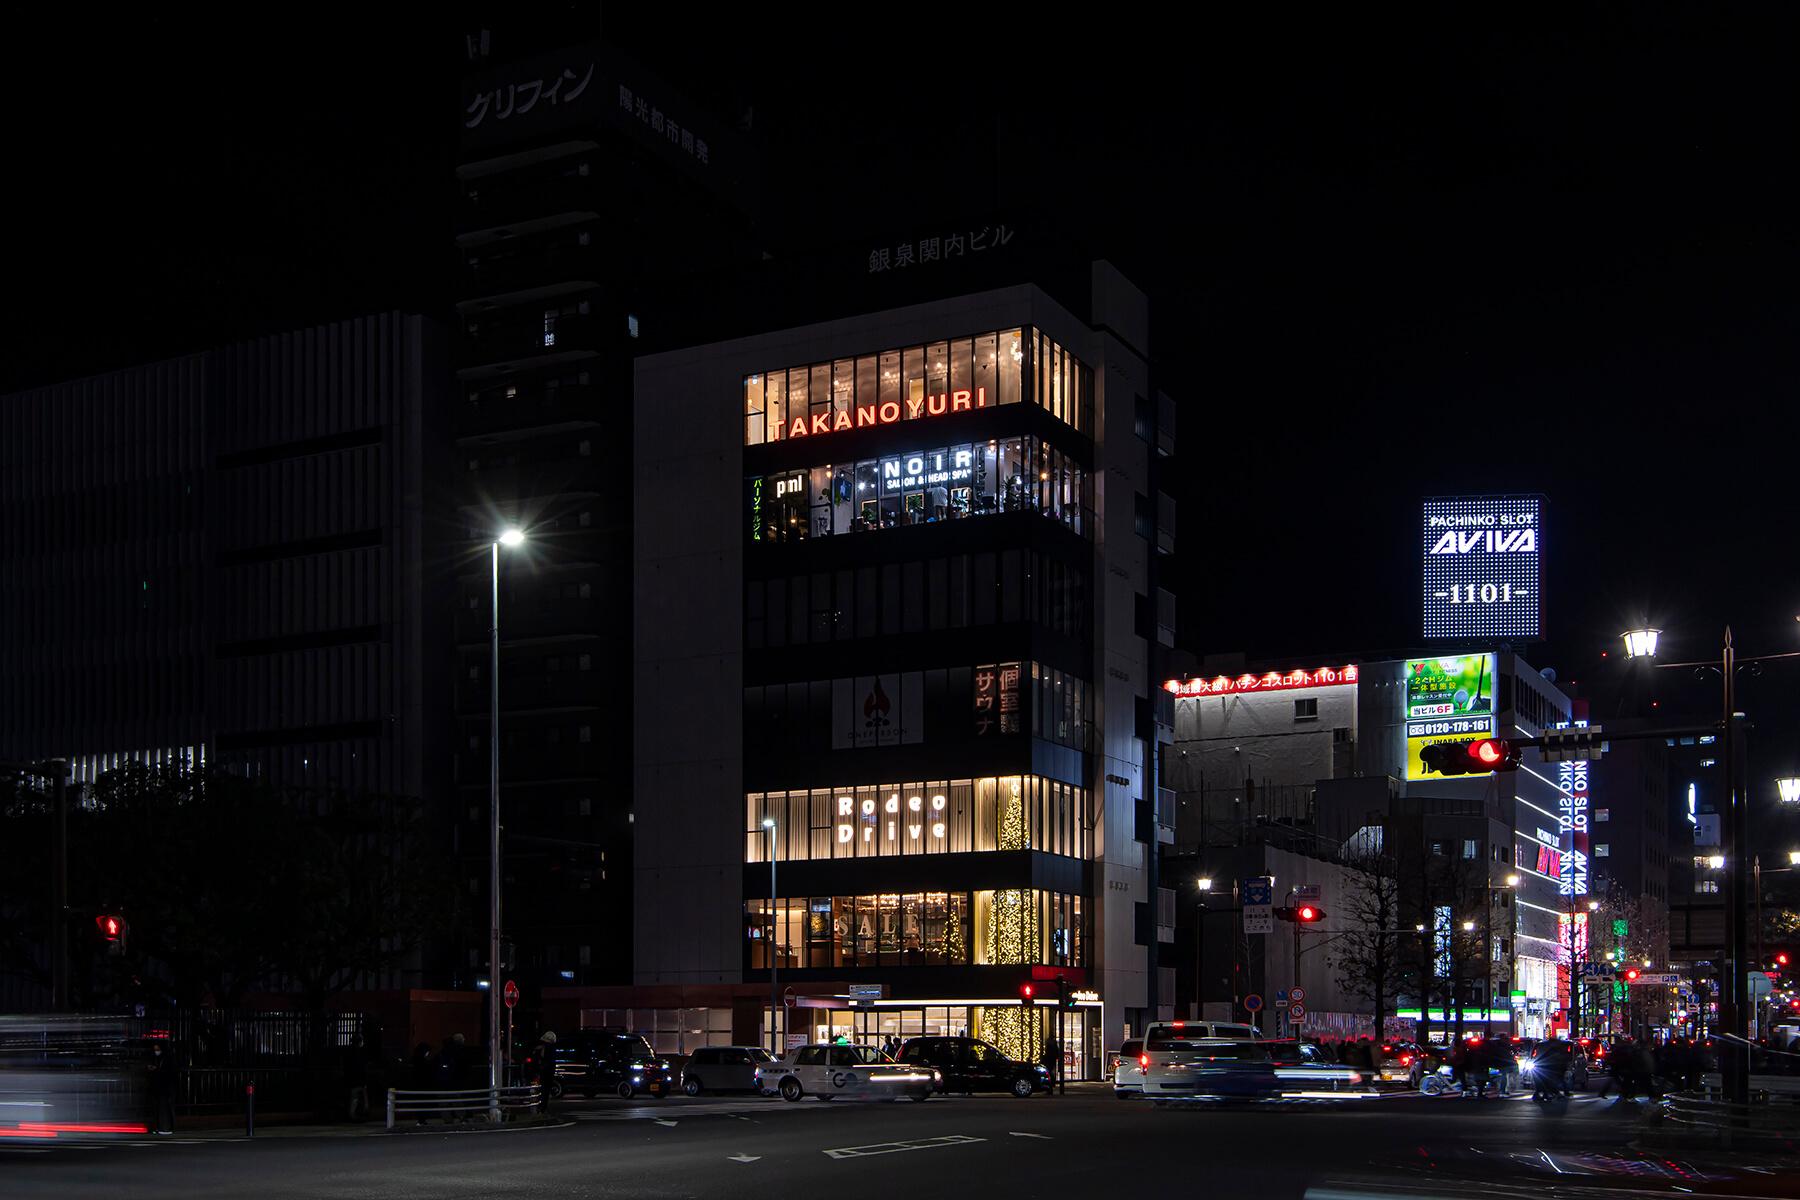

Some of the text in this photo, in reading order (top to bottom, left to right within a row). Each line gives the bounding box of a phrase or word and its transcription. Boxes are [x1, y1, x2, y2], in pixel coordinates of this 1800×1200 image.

[465, 62, 595, 128] グリフィン
[868, 224, 1015, 273] 銀泉関内ビル
[885, 450, 972, 479] NOIR
[1429, 513, 1535, 527] PACHINKO SLOT
[1429, 528, 1535, 554] AVIVA
[975, 672, 995, 735] サウナ
[1425, 719, 1490, 734] 0120-178-161
[838, 793, 946, 816] Rodeo
[1573, 796, 1588, 834] SLOT
[838, 821, 946, 844] Drive
